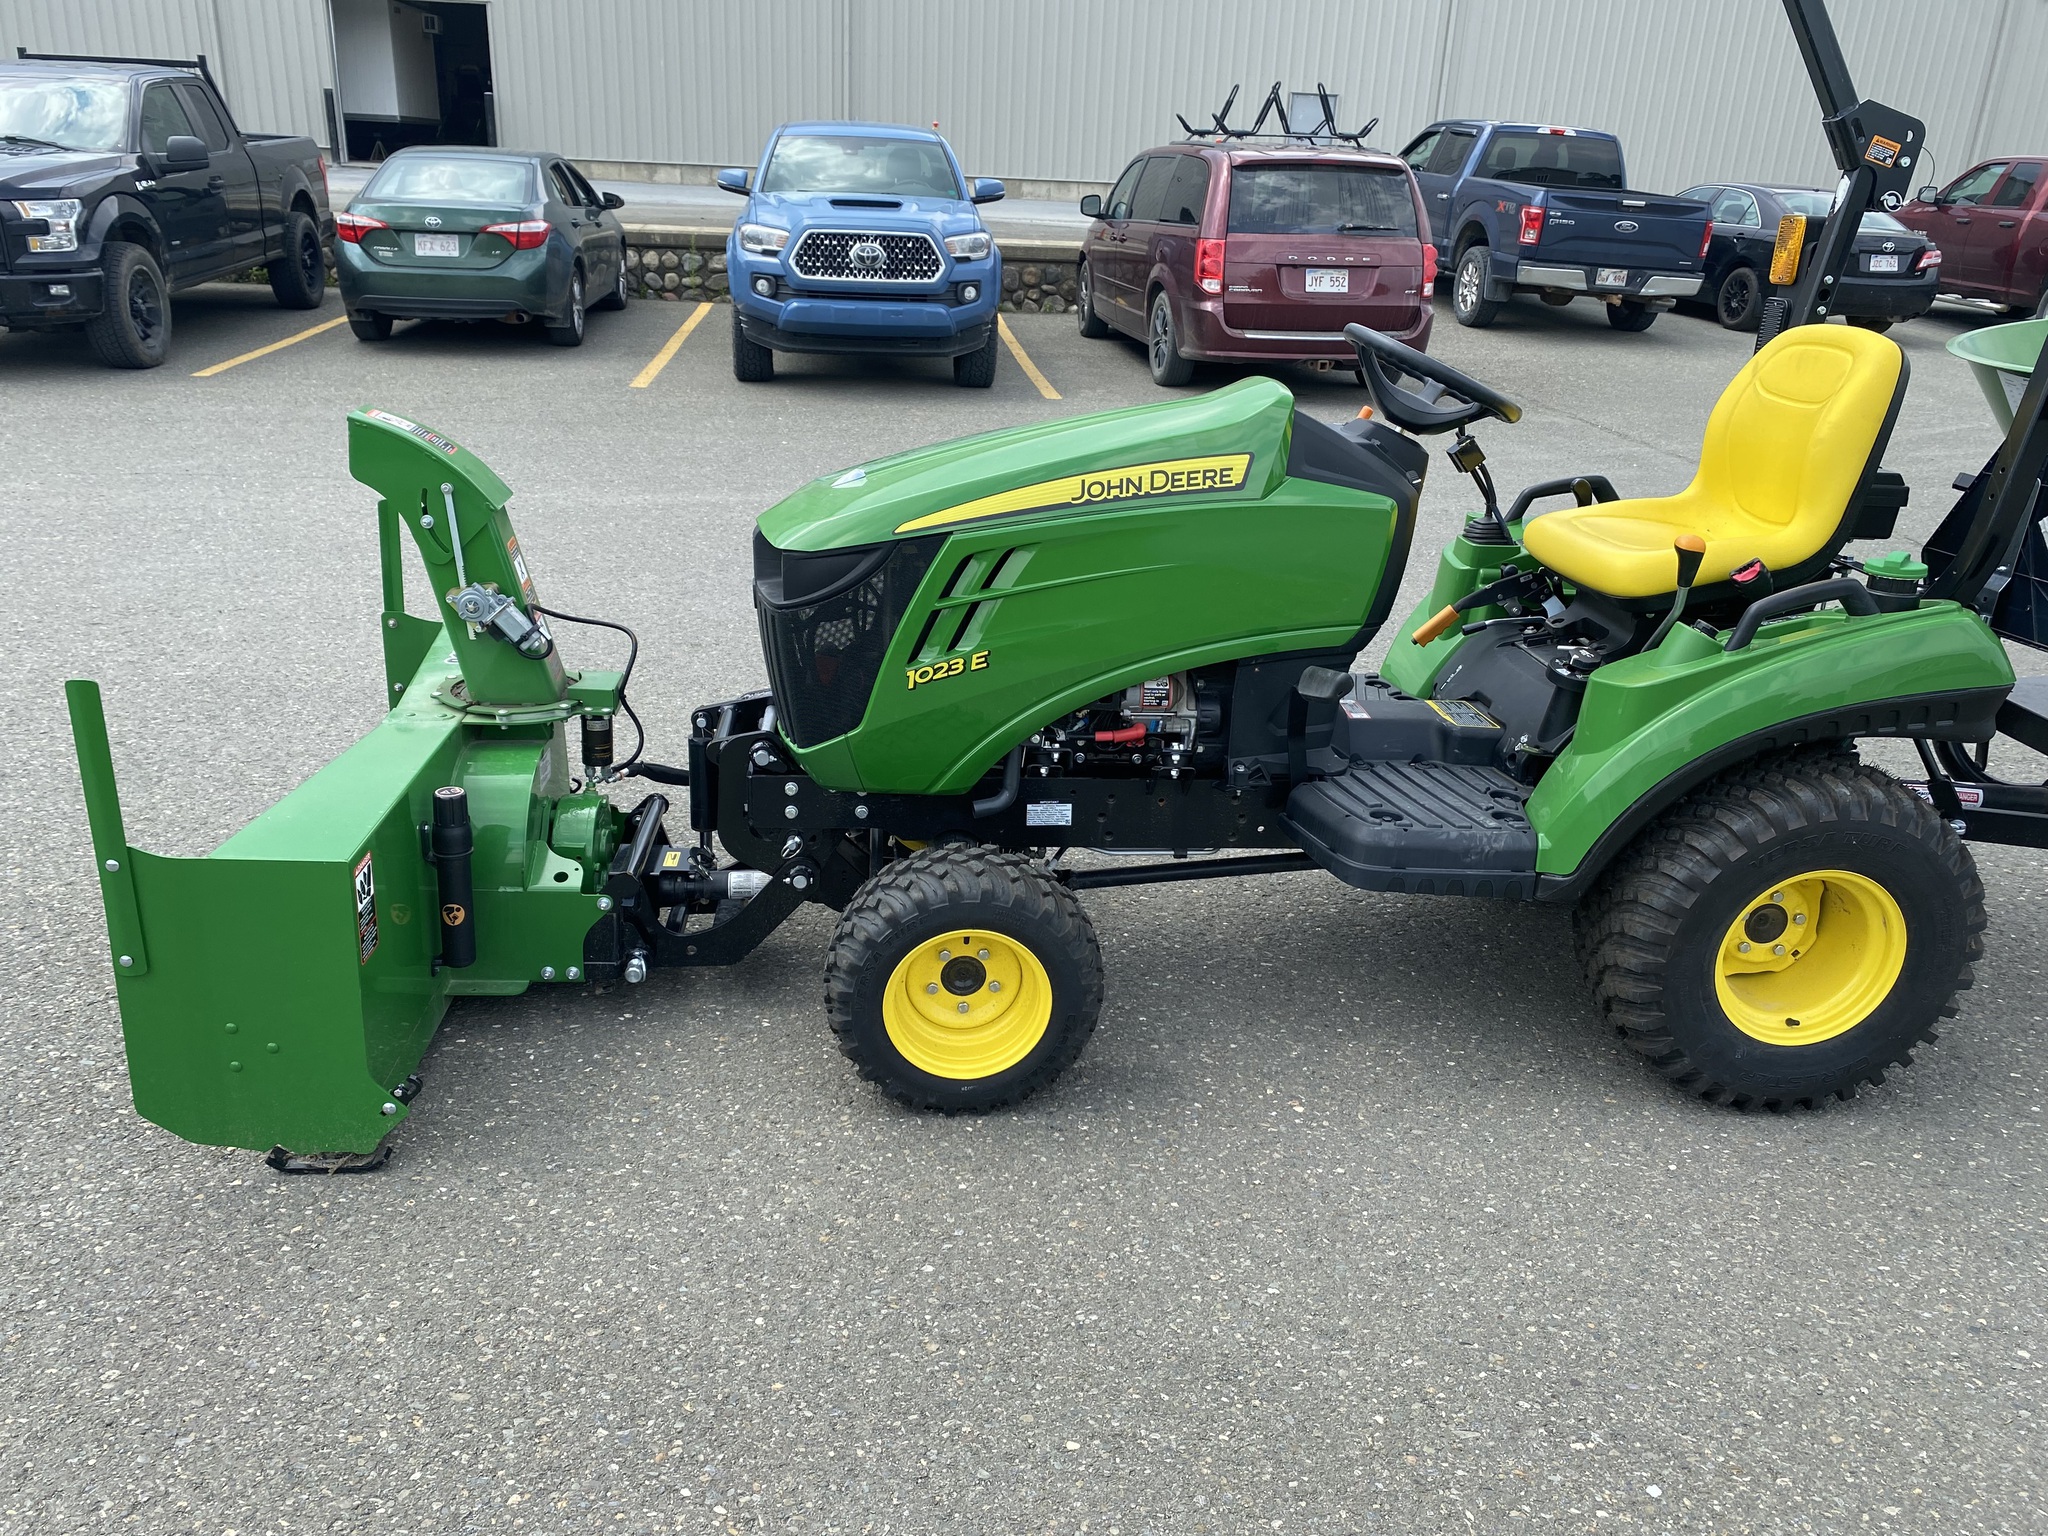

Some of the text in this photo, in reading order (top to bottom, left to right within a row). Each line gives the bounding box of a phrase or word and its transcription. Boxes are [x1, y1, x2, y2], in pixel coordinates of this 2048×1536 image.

[417, 241, 457, 251] KFX 623
[1308, 276, 1346, 287] JYF 552
[1613, 275, 1625, 283] 494
[1071, 467, 1234, 502] JOHN DEERE
[906, 650, 989, 690] 1023 E
